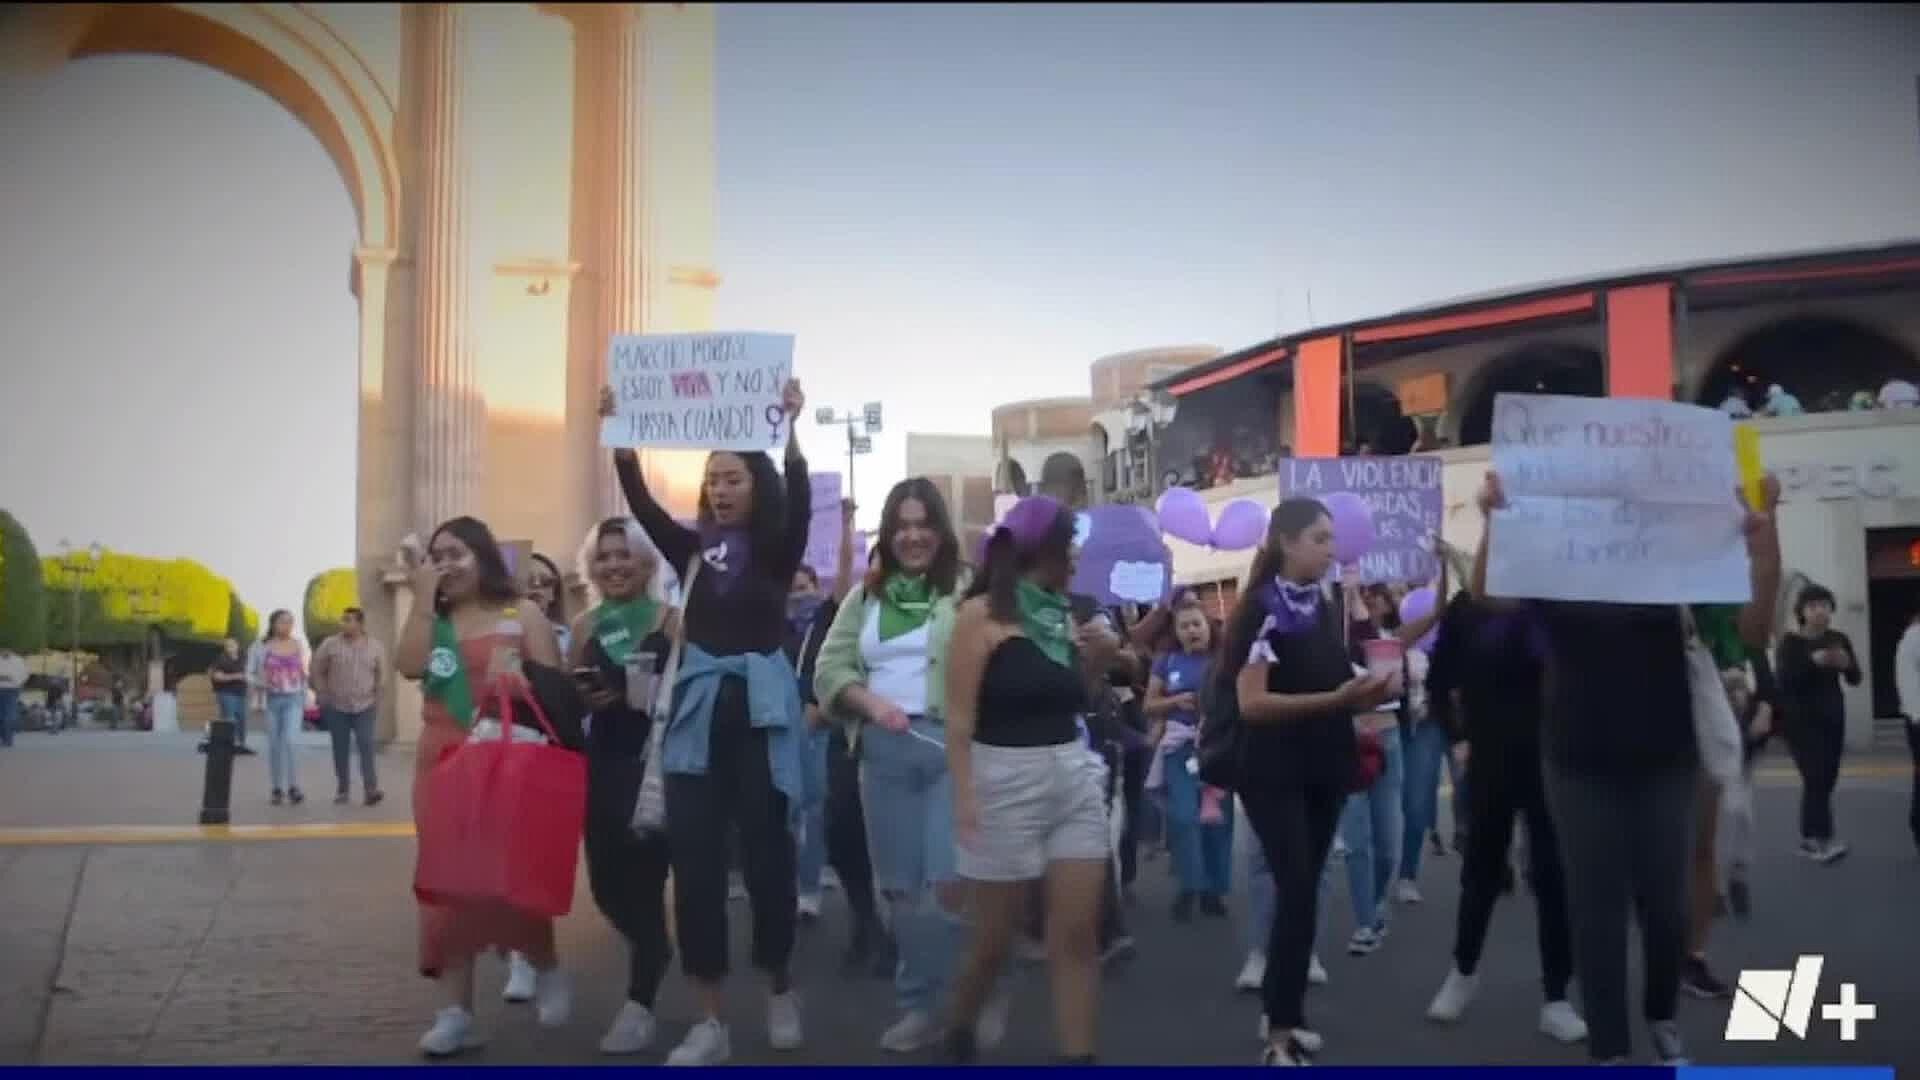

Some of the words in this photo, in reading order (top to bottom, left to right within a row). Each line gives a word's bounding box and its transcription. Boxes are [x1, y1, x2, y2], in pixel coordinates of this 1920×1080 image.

[715, 370, 730, 396] Y
[734, 367, 762, 394] NO
[1289, 461, 1323, 490] LA
